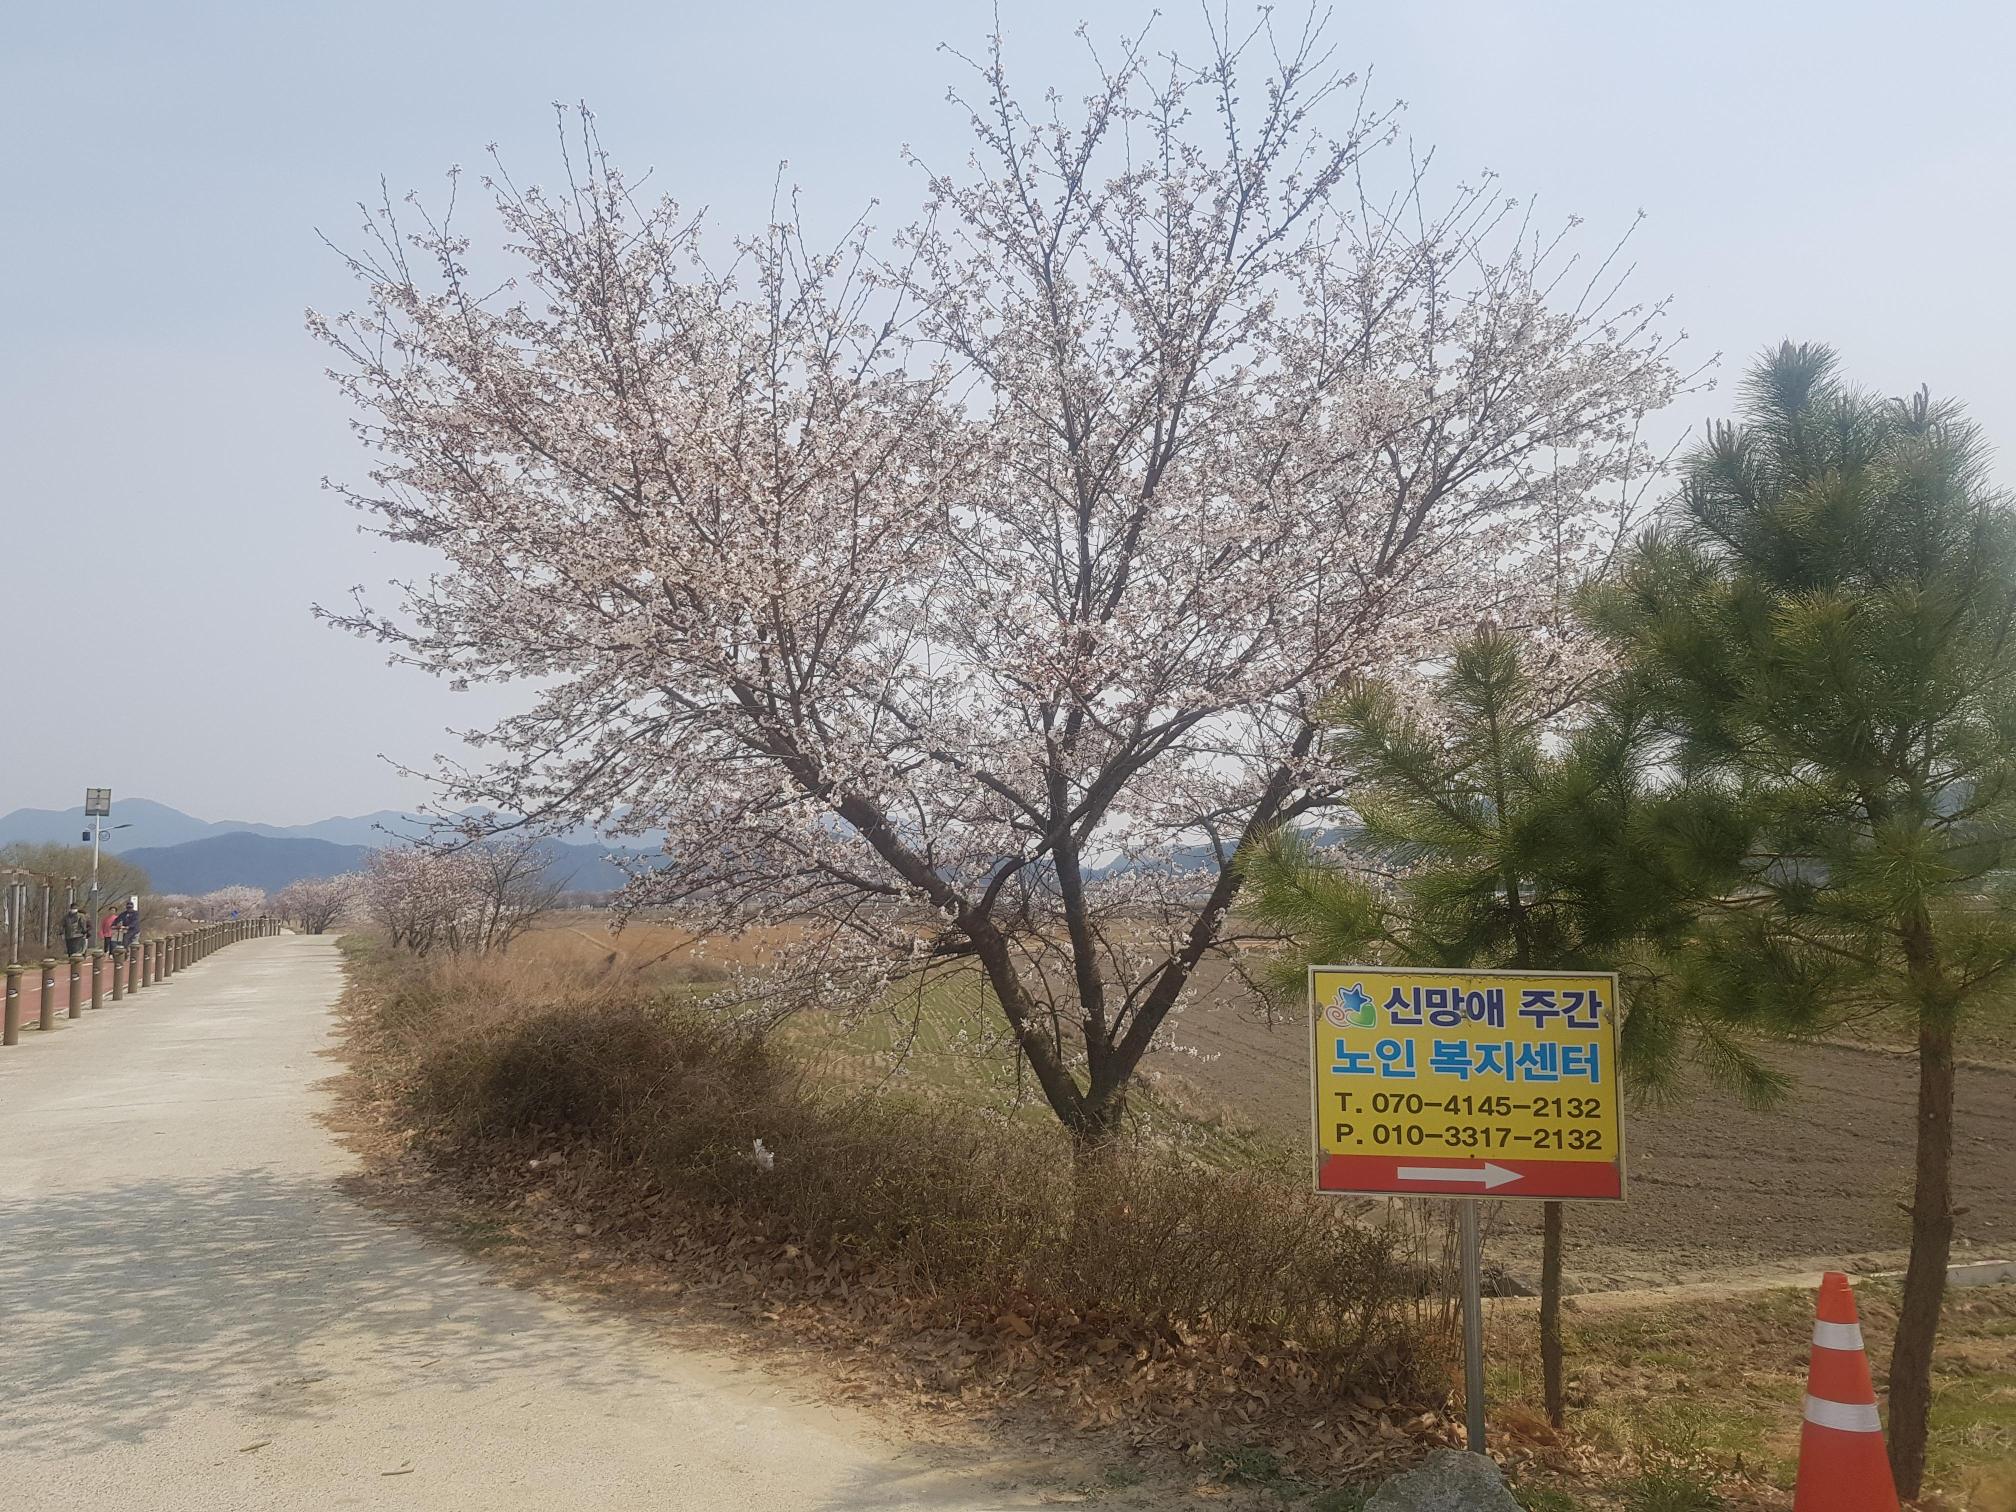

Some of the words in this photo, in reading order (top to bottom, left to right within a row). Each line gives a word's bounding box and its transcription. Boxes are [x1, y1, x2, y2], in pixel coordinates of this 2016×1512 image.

[1383, 986, 1505, 1028] 신망애
[1518, 990, 1603, 1029] 주간
[1331, 1038, 1416, 1078] 노인
[1429, 1039, 1601, 1083] 복지센터
[1334, 1092, 1363, 1114] T.
[1372, 1092, 1601, 1119] 070-4145-2132
[1335, 1123, 1363, 1145] P.
[1372, 1123, 1602, 1150] 010-3317-2132
